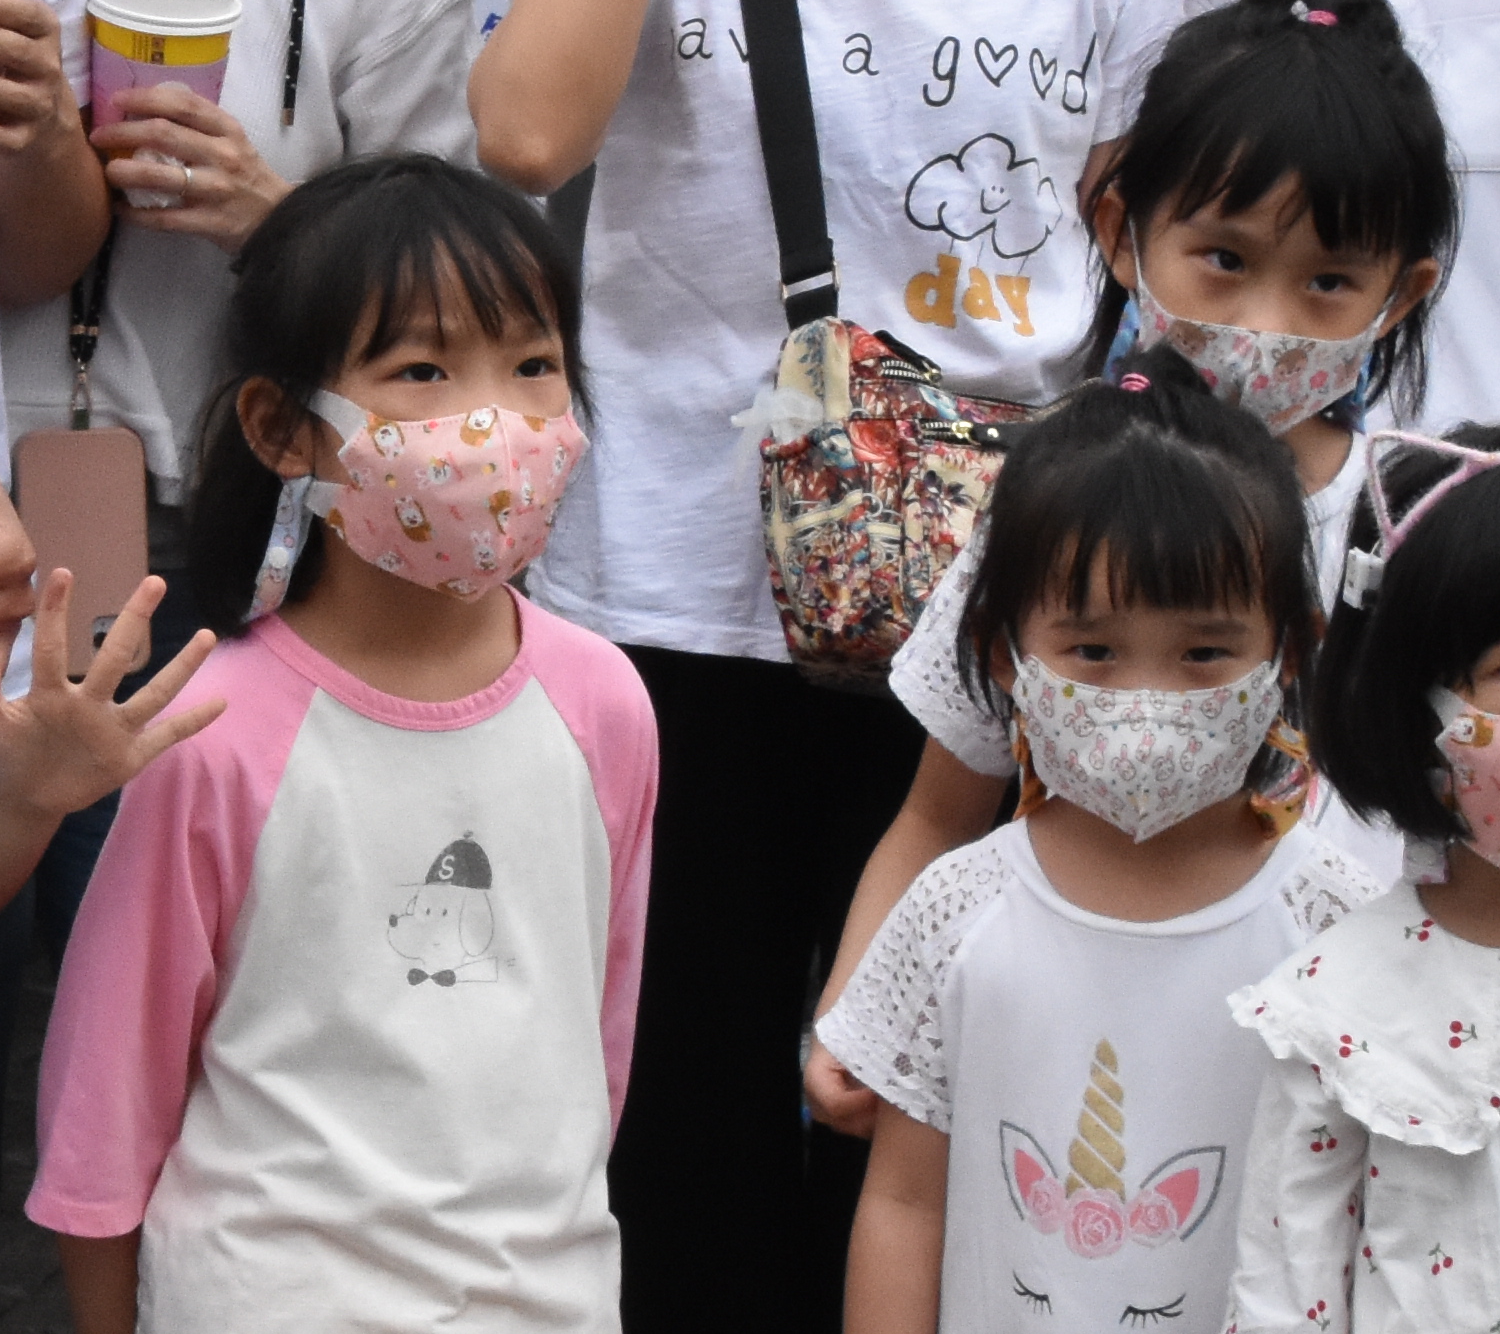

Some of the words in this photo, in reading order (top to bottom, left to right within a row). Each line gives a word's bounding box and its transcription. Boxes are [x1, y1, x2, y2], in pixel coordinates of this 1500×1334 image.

[842, 33, 879, 77] a
[904, 252, 1035, 337] day
[438, 855, 455, 880] S
